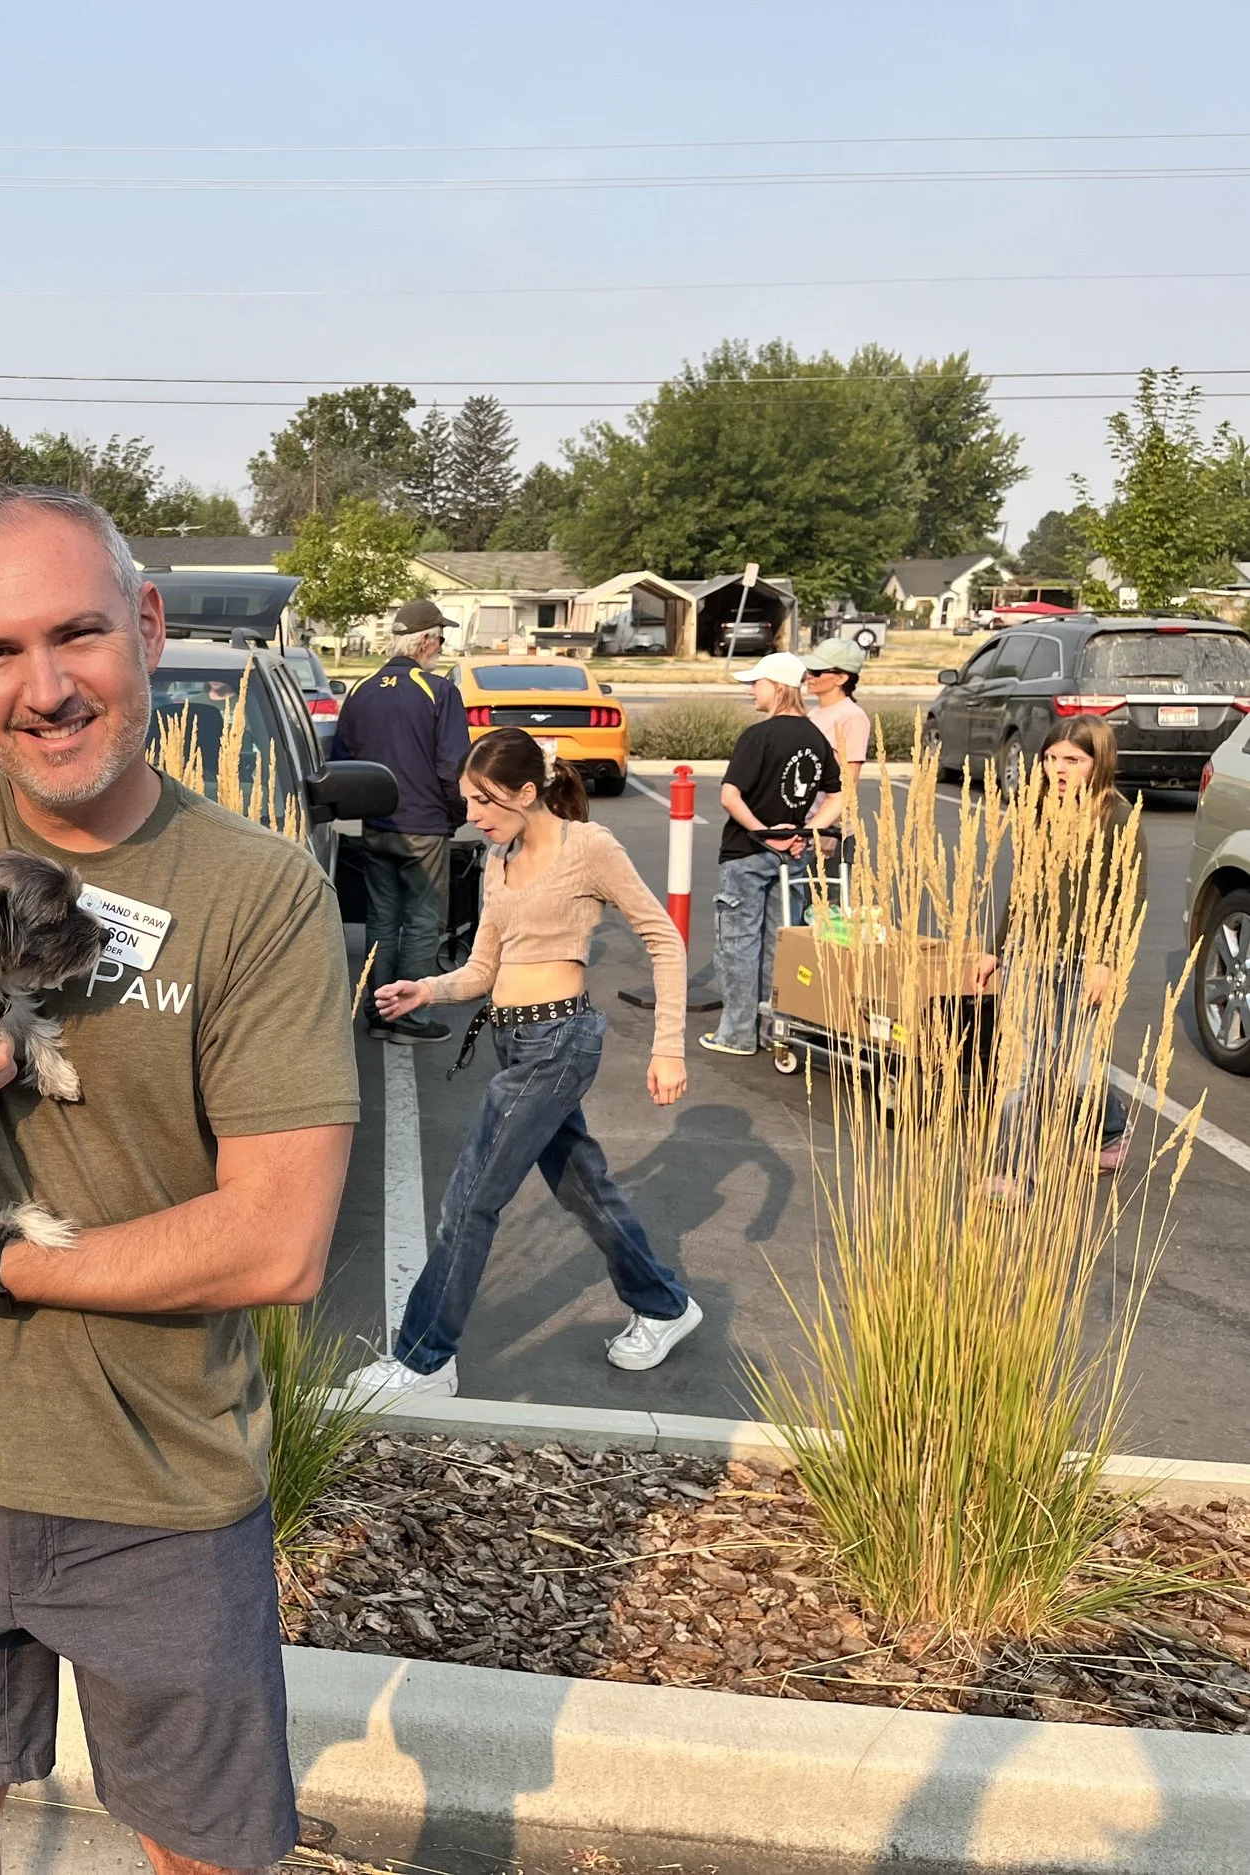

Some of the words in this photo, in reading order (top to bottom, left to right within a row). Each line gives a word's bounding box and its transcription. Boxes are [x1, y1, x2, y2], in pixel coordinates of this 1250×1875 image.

[379, 675, 397, 688] 34
[102, 901, 131, 918] HAND
[132, 912, 140, 921] &
[142, 915, 166, 930] PAW
[108, 927, 139, 948] SON
[105, 945, 123, 956] DER
[86, 957, 193, 1015] PAW
